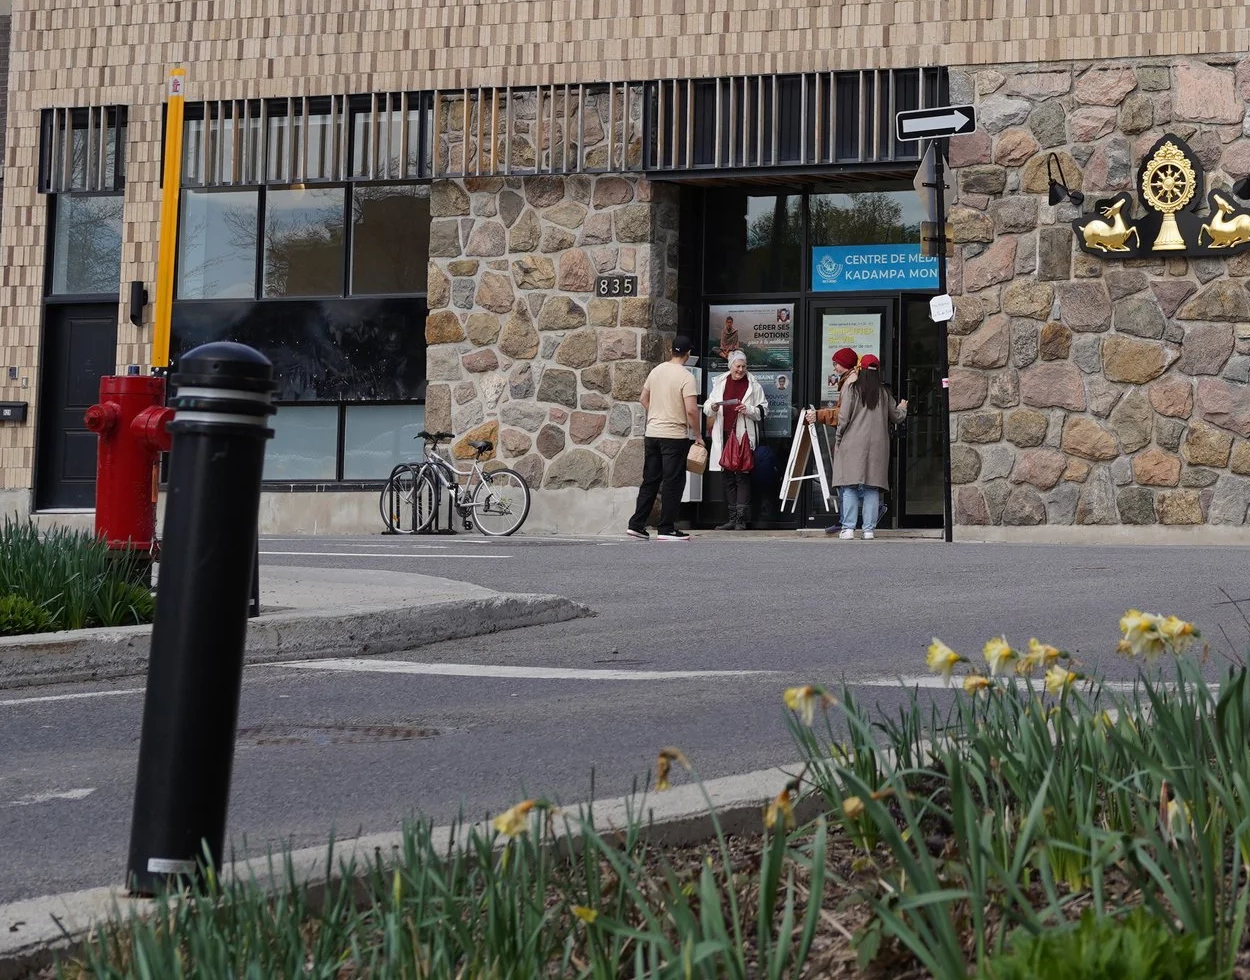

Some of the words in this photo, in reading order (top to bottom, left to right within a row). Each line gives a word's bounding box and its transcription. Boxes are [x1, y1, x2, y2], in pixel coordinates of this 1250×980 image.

[845, 254, 888, 265] CENTRE
[890, 253, 906, 263] DE
[845, 269, 906, 280] KADAMPA
[909, 268, 938, 278] MON
[600, 278, 632, 294] 835
[777, 323, 790, 331] SES
[753, 331, 790, 339] ÉMOTIONS
